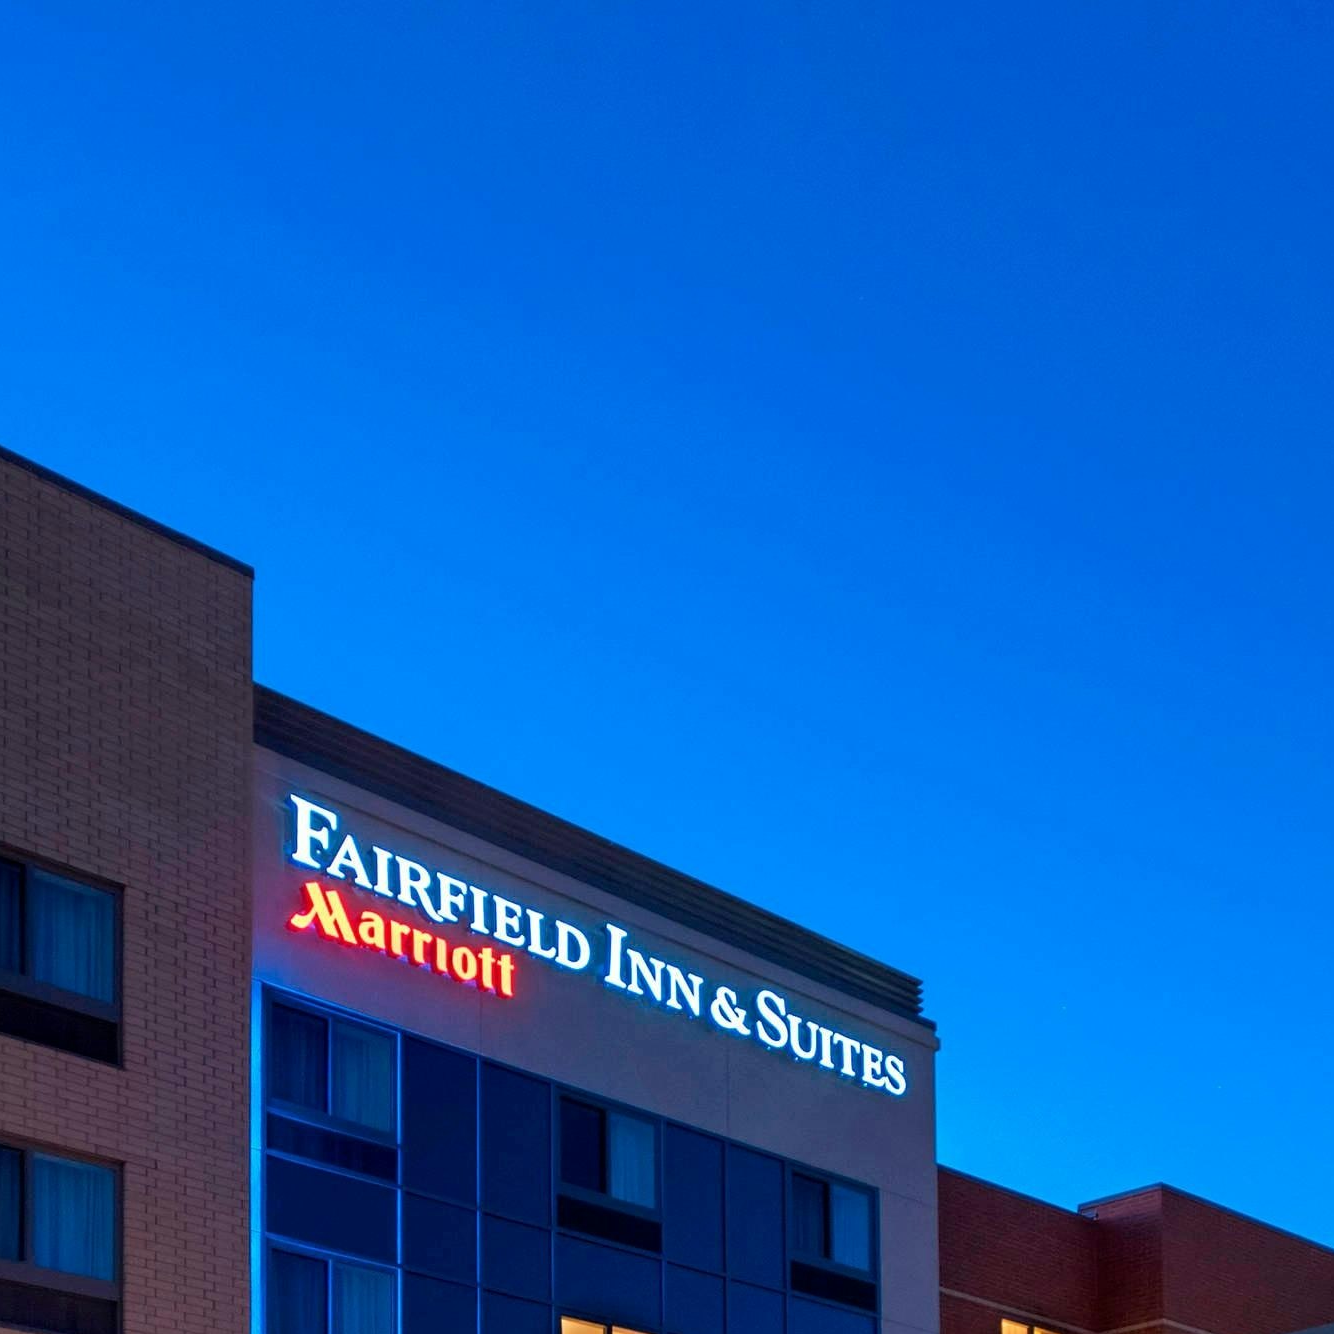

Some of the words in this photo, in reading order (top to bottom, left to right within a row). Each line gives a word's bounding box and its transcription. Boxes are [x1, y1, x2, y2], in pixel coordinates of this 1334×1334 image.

[289, 881, 515, 998] Marriott
[290, 793, 591, 970] FAIRFIELD
[604, 923, 704, 1027] INN
[710, 985, 751, 1035] &
[755, 989, 907, 1096] SUITES
